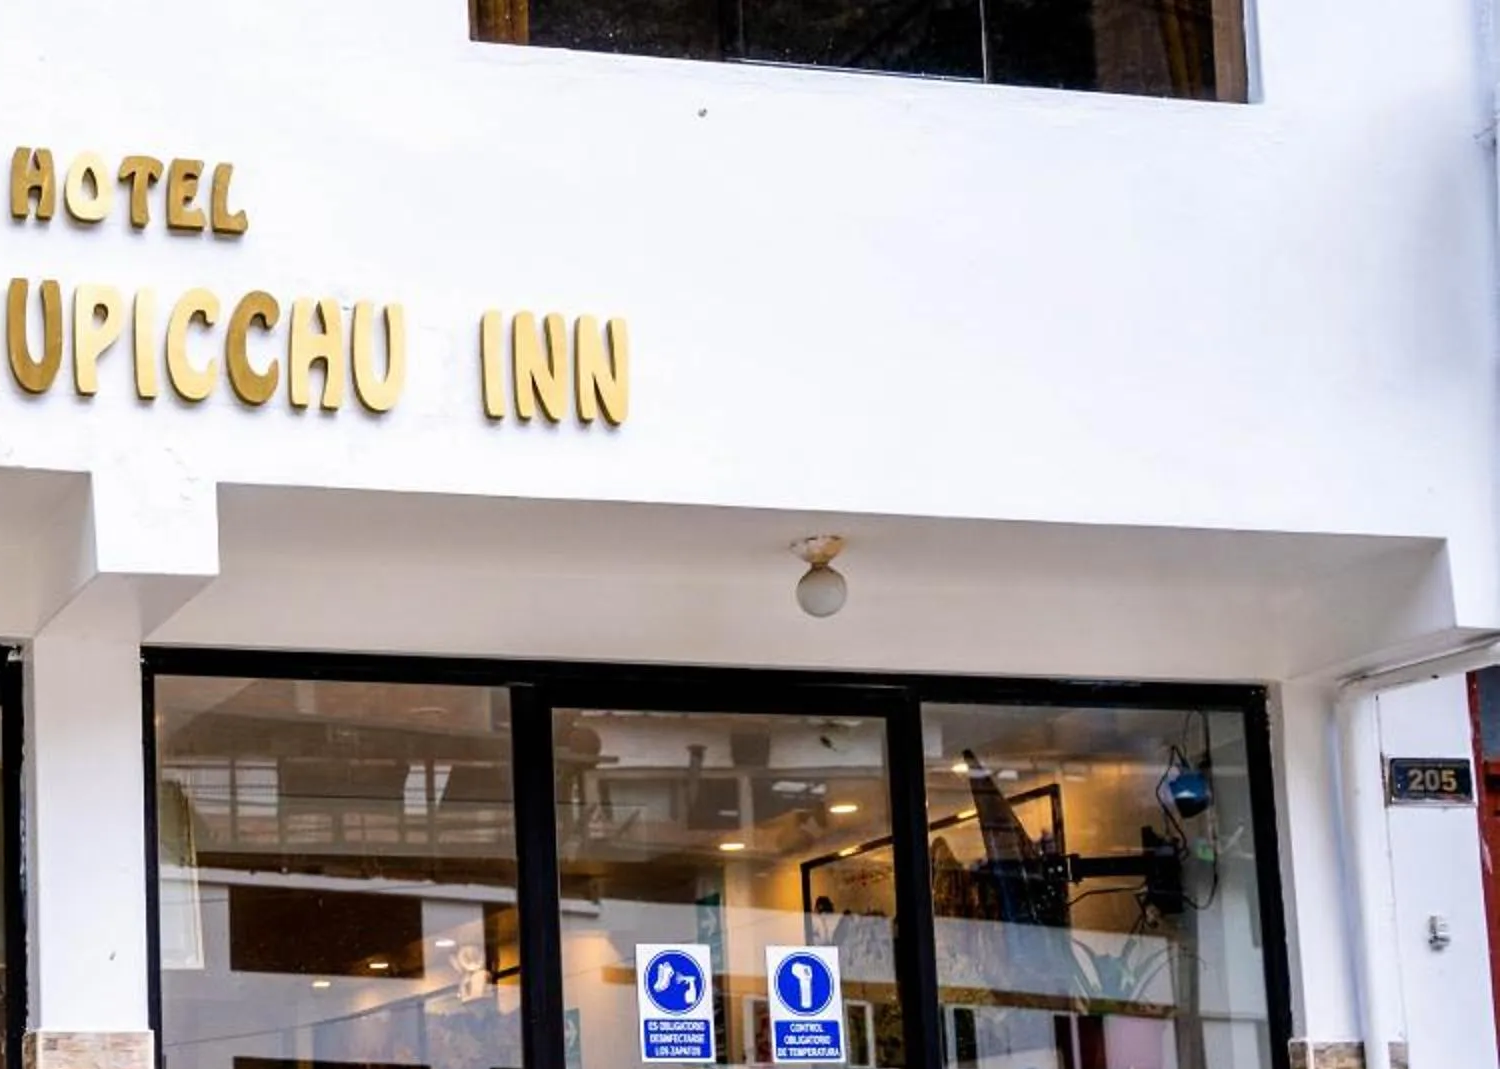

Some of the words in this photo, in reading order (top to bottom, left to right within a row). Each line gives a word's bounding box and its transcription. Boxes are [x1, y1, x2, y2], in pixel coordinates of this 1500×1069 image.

[9, 146, 248, 236] HOTEL
[479, 310, 629, 426] INN
[1407, 768, 1458, 793] 205
[789, 1024, 823, 1033] CONTROL
[790, 1048, 840, 1057] TEMPERATURA
